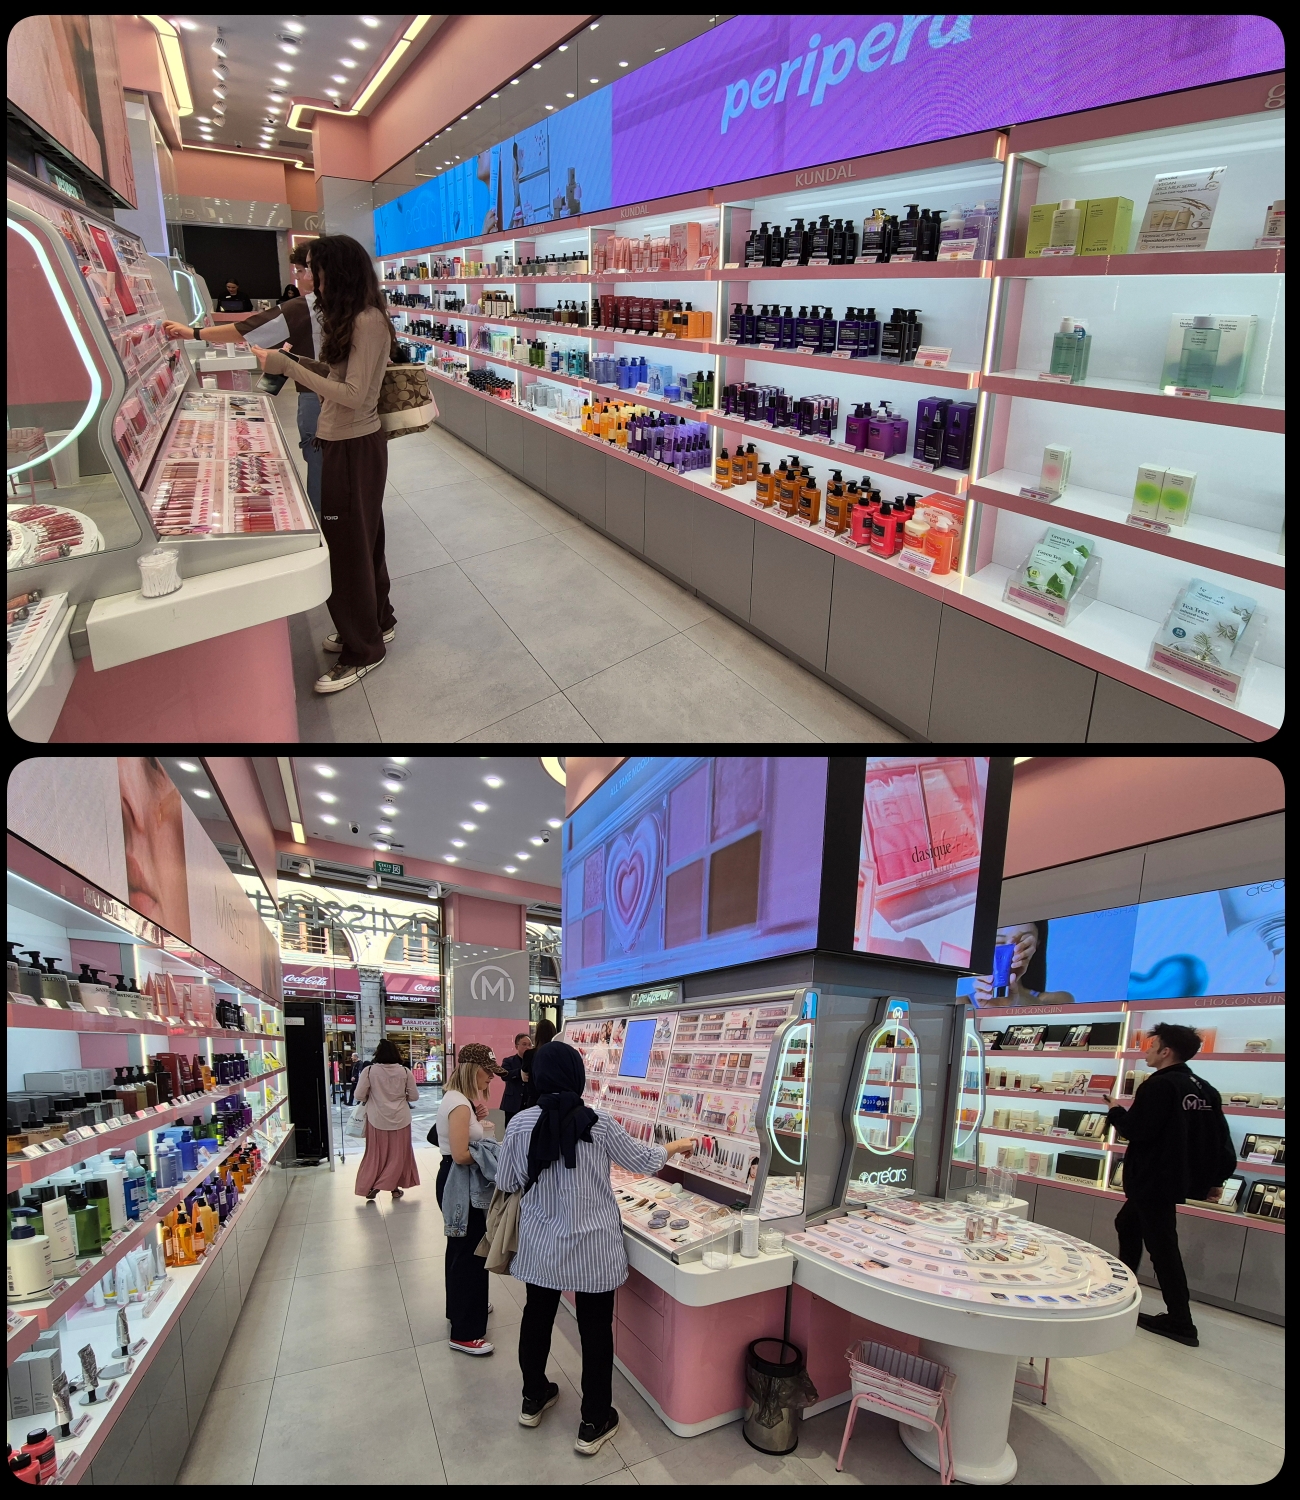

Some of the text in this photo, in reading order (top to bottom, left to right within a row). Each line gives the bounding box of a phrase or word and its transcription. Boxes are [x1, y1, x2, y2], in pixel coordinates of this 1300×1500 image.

[720, 15, 973, 134] peripera
[795, 164, 857, 187] KUNDAL
[620, 204, 650, 219] KUNDAL
[1181, 602, 1210, 617] Tea Tree
[619, 774, 632, 789] TAKE
[911, 842, 952, 864] dasique
[1093, 905, 1137, 919] MISSHA
[283, 974, 329, 986] Coca-Cola
[528, 994, 559, 1004] POINT
[1006, 1006, 1063, 1015] CHOGONGJIN
[1057, 1174, 1095, 1186] CHOGONGJIN
